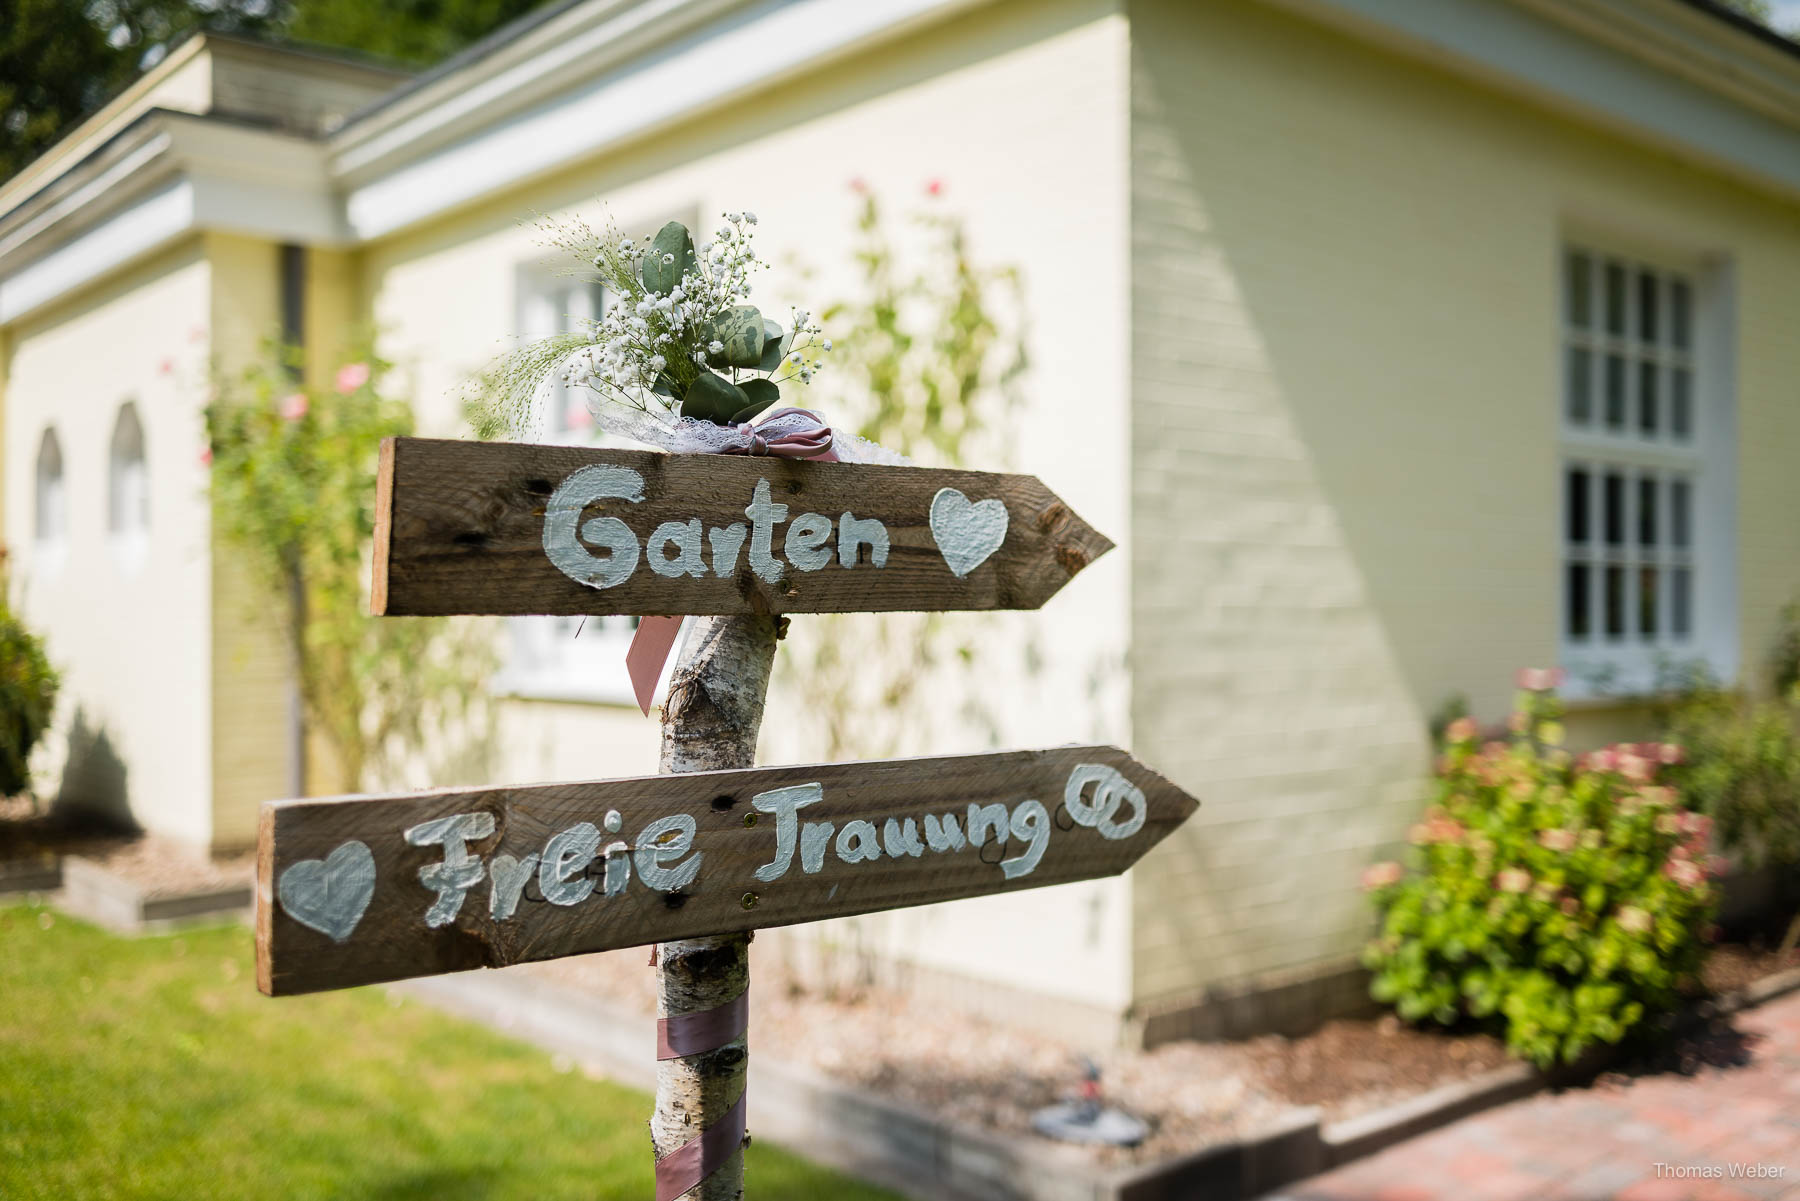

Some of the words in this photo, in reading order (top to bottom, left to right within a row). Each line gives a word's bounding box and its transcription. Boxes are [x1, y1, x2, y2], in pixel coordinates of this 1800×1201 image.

[542, 463, 891, 590] Garten
[403, 809, 702, 928] Freie
[752, 782, 1051, 882] Trauung
